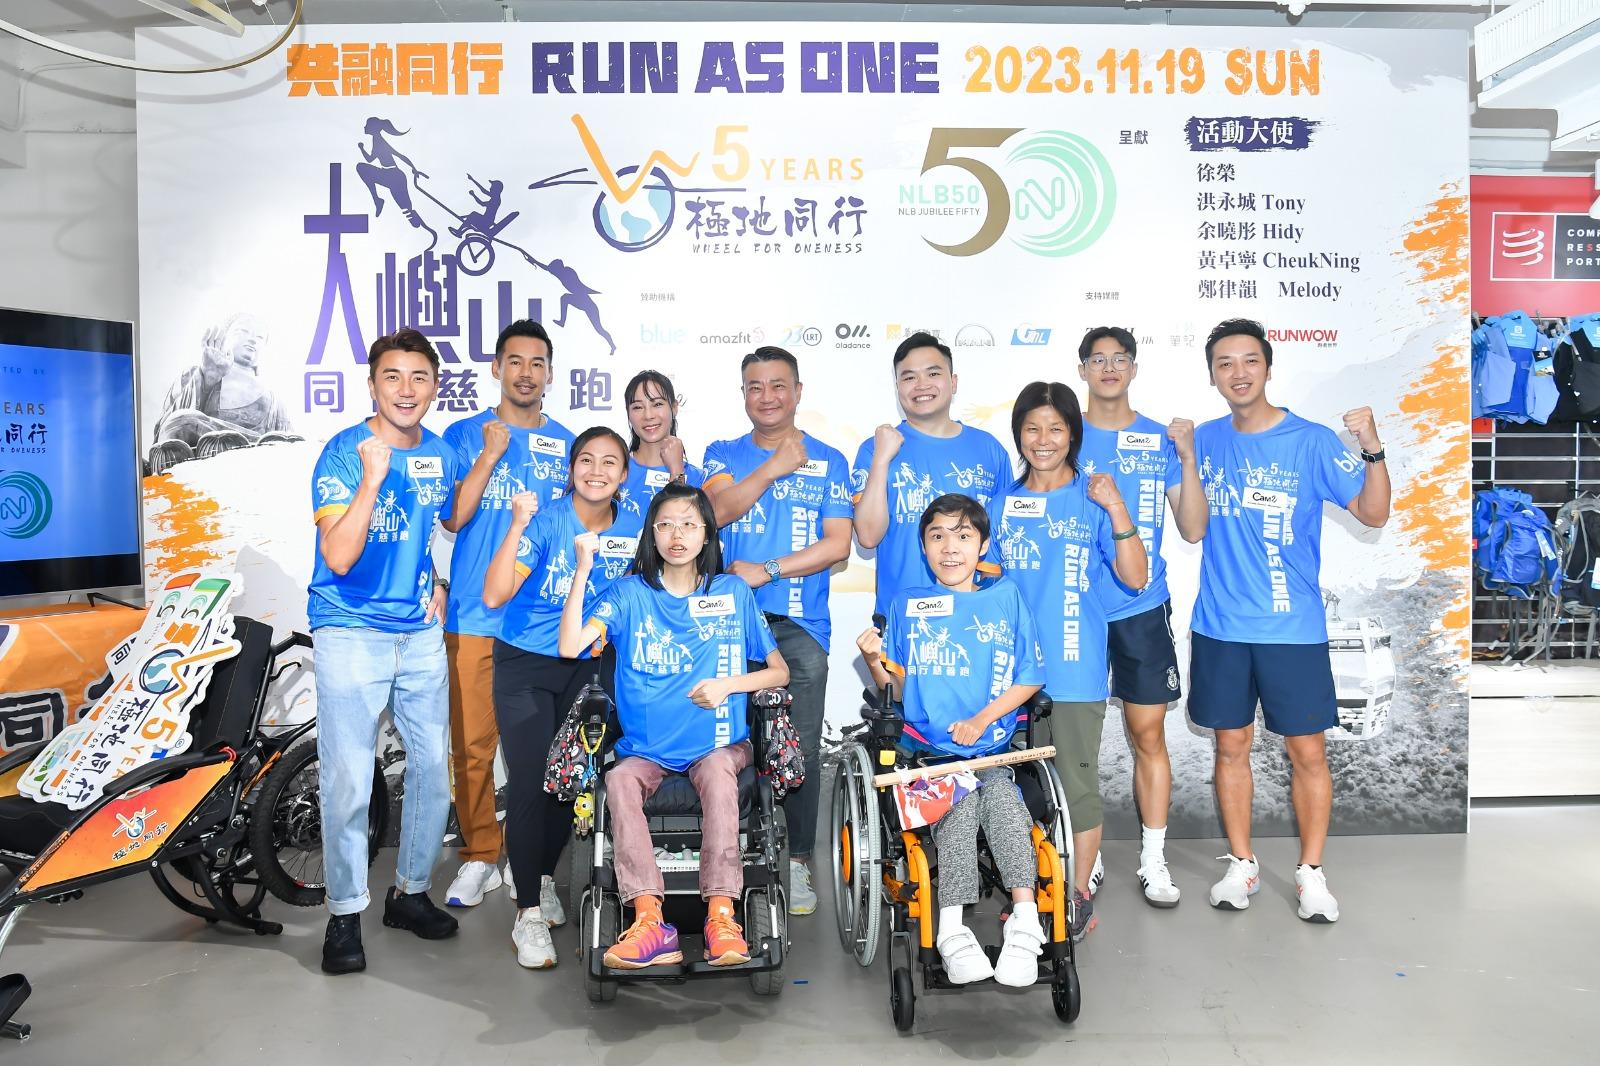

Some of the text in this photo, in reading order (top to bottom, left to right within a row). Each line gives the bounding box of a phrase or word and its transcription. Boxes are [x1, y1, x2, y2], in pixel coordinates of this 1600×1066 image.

[286, 42, 503, 96] 共融同行
[532, 42, 940, 94] RUN AS ONE
[965, 45, 1322, 96] 2023.11.19 SUN
[1119, 130, 1149, 145] 呈獻
[1196, 120, 1294, 145] 活動大使
[711, 125, 864, 182] 5 YEARS
[1197, 163, 1235, 182] 徐榮
[899, 184, 980, 205] NLB50
[1197, 192, 1306, 215] 洪永城 Tony
[685, 196, 867, 238] 極地同行
[1197, 221, 1304, 244] 余曉彤 Hidy
[692, 243, 863, 254] WHEEL FOR ONENESS
[1198, 250, 1360, 274] 黃卓寧 CheukNing
[1278, 281, 1342, 301] Melody
[700, 333, 751, 344] amazfit
[1268, 330, 1338, 342] RUNWOW
[304, 368, 612, 413] 同慈跑
[1139, 480, 1155, 522] RUN
[792, 506, 807, 551] RUN
[1263, 510, 1281, 540] UN
[1065, 543, 1080, 587] RUN
[1264, 541, 1283, 568] AS
[1064, 590, 1079, 617] AS
[1270, 571, 1290, 612] ONE
[1064, 620, 1079, 662] ONE
